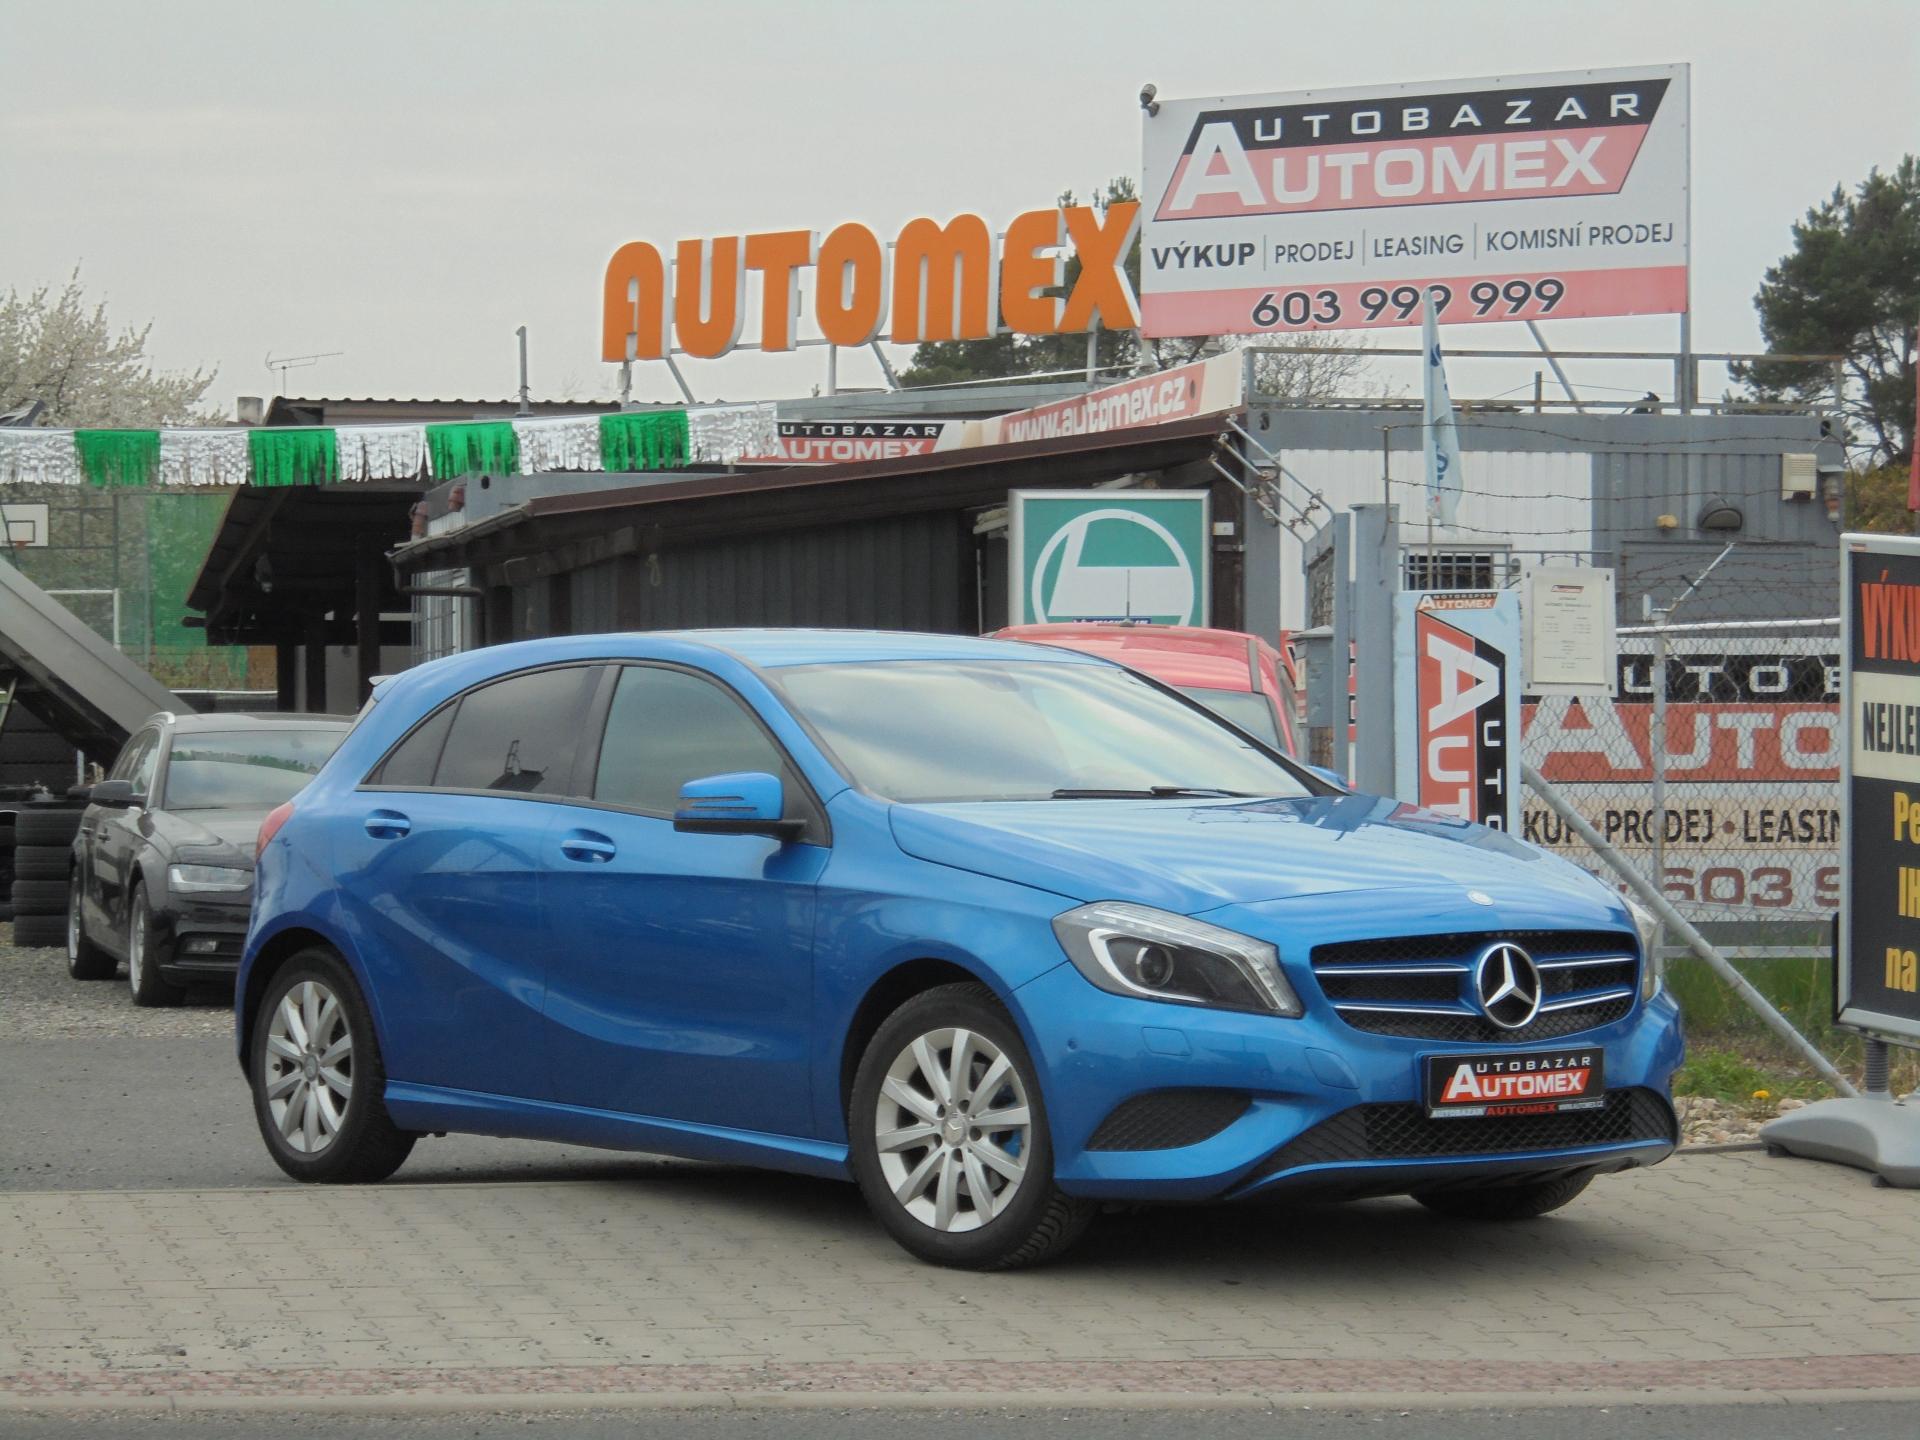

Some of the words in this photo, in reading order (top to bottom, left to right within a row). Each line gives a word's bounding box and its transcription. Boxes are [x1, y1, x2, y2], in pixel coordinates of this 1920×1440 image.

[1167, 121, 1607, 212] AUTOMEX
[1151, 241, 1256, 272] VÝKUP
[1273, 240, 1355, 265] PRODEJ
[1373, 233, 1465, 259] LEASING
[1485, 221, 1583, 253] KOMISNÍ
[1588, 222, 1674, 248] PRODEJ
[602, 201, 1140, 363] AUTOMEX
[1250, 290, 1342, 328] 603
[1359, 284, 1453, 323] 999
[1468, 278, 1565, 317] 999
[1008, 376, 1187, 444] www.automex.cz
[1604, 809, 1714, 844] PRODEJ
[1884, 947, 1918, 993] na
[1447, 1064, 1583, 1099] AUTOMEX
[1486, 1102, 1557, 1117] AUTOMEX
